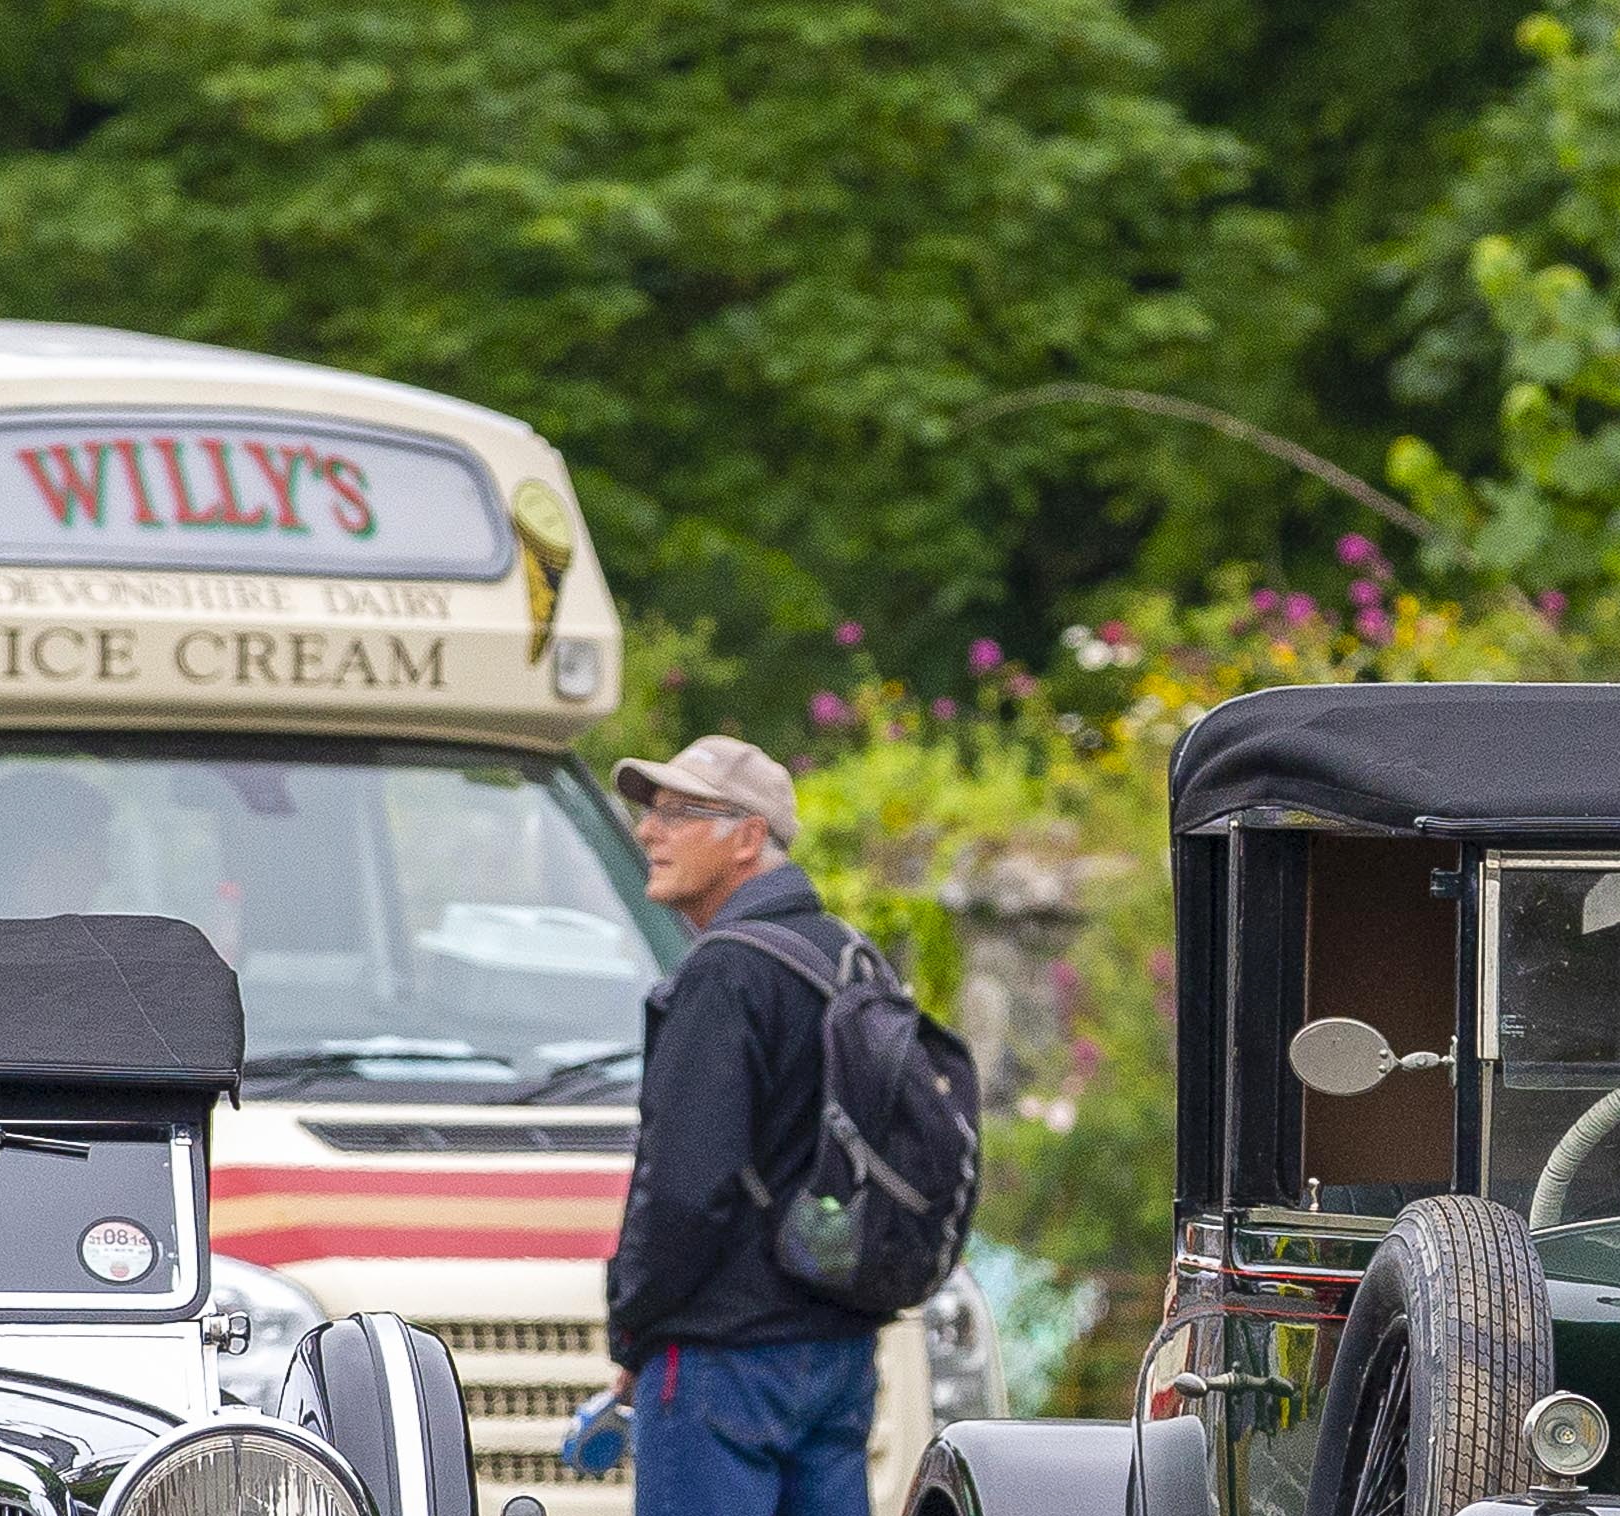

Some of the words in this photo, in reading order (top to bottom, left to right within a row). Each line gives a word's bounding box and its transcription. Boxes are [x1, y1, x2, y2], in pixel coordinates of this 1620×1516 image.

[16, 436, 380, 540] WILLY'S
[323, 580, 454, 622] DAIRY
[0, 622, 142, 682] ICE
[173, 628, 450, 692] CREAM
[104, 1229, 128, 1245] 08
